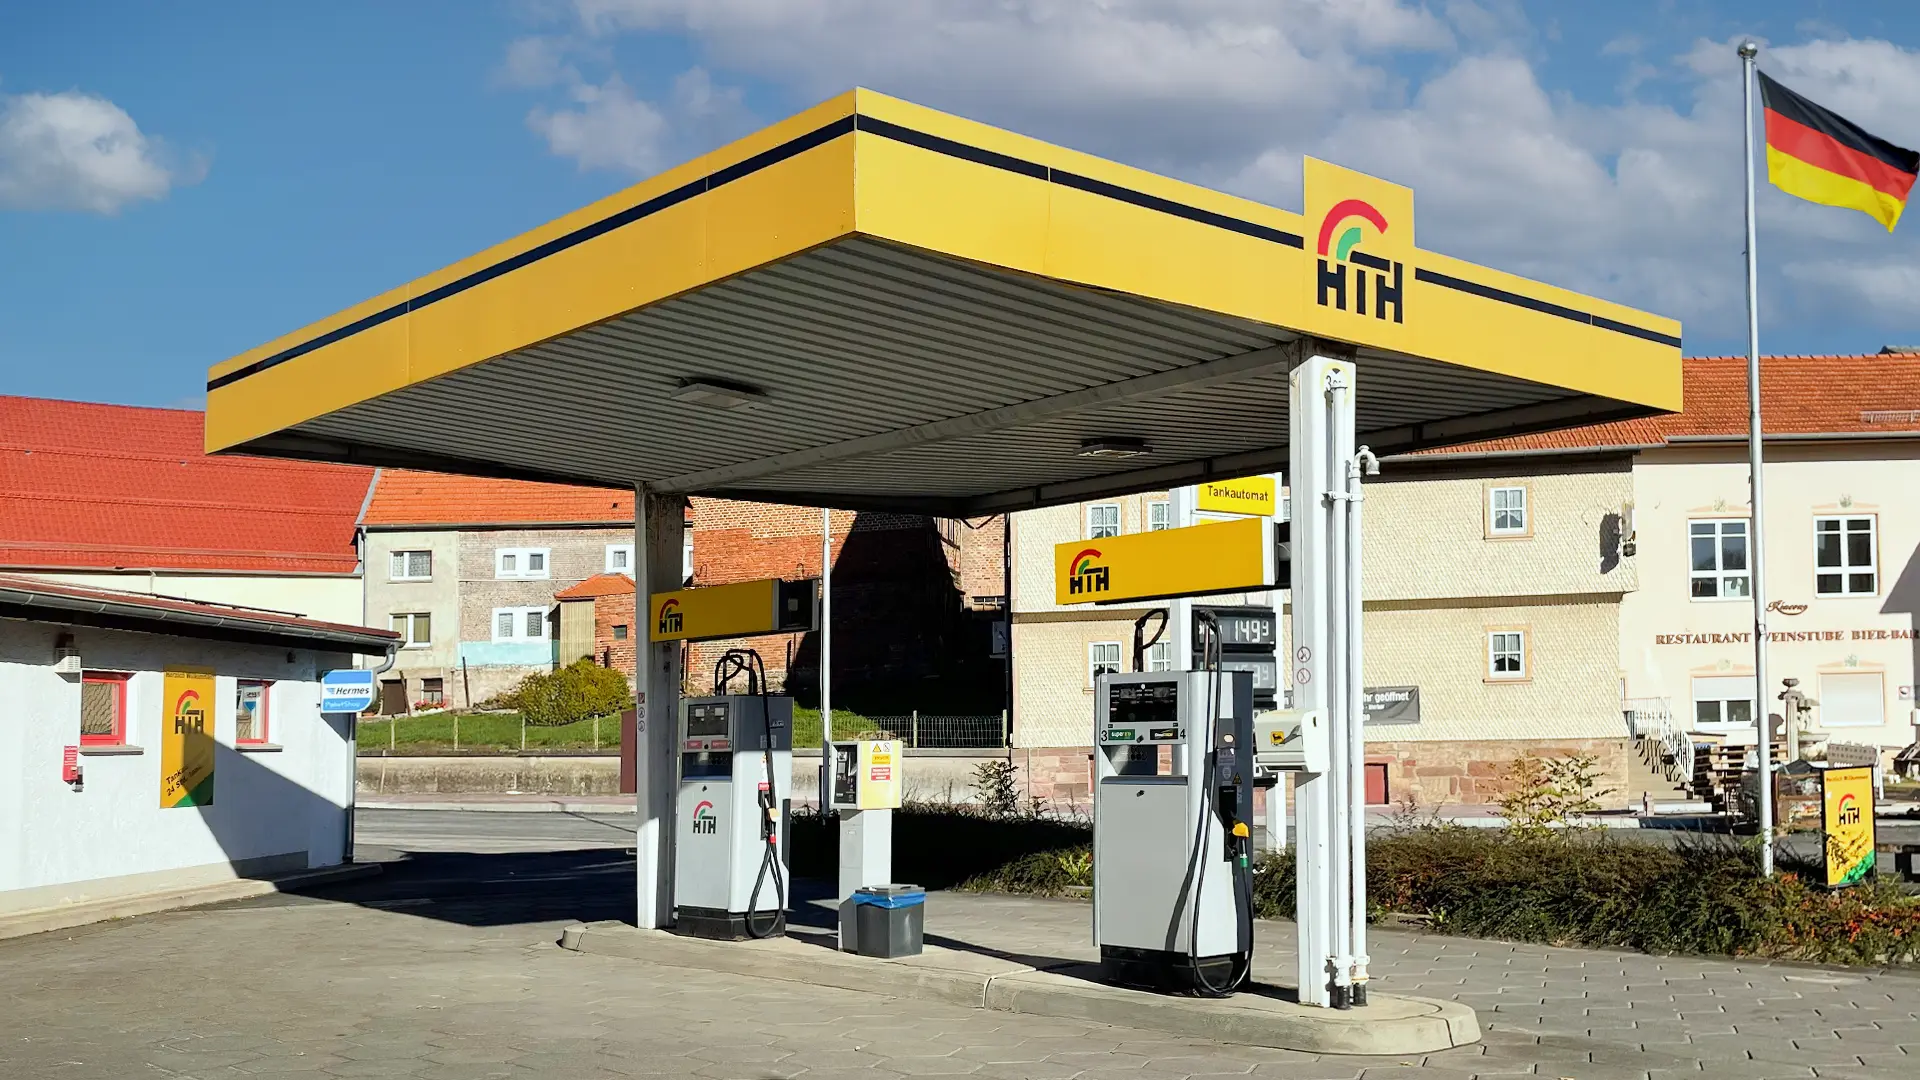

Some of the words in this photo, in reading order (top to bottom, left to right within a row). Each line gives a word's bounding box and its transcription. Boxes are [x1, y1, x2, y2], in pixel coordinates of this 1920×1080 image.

[1317, 250, 1403, 324] HTH
[1207, 485, 1268, 501] Tankautomat
[1069, 566, 1109, 594] HTH
[658, 612, 683, 634] HTH
[1655, 632, 1751, 644] RESTAURANT
[336, 687, 370, 695] Hermes
[1374, 691, 1410, 703] geöffnet
[1101, 729, 1108, 742] 3
[1180, 728, 1187, 740] 4
[693, 815, 717, 834] HTH
